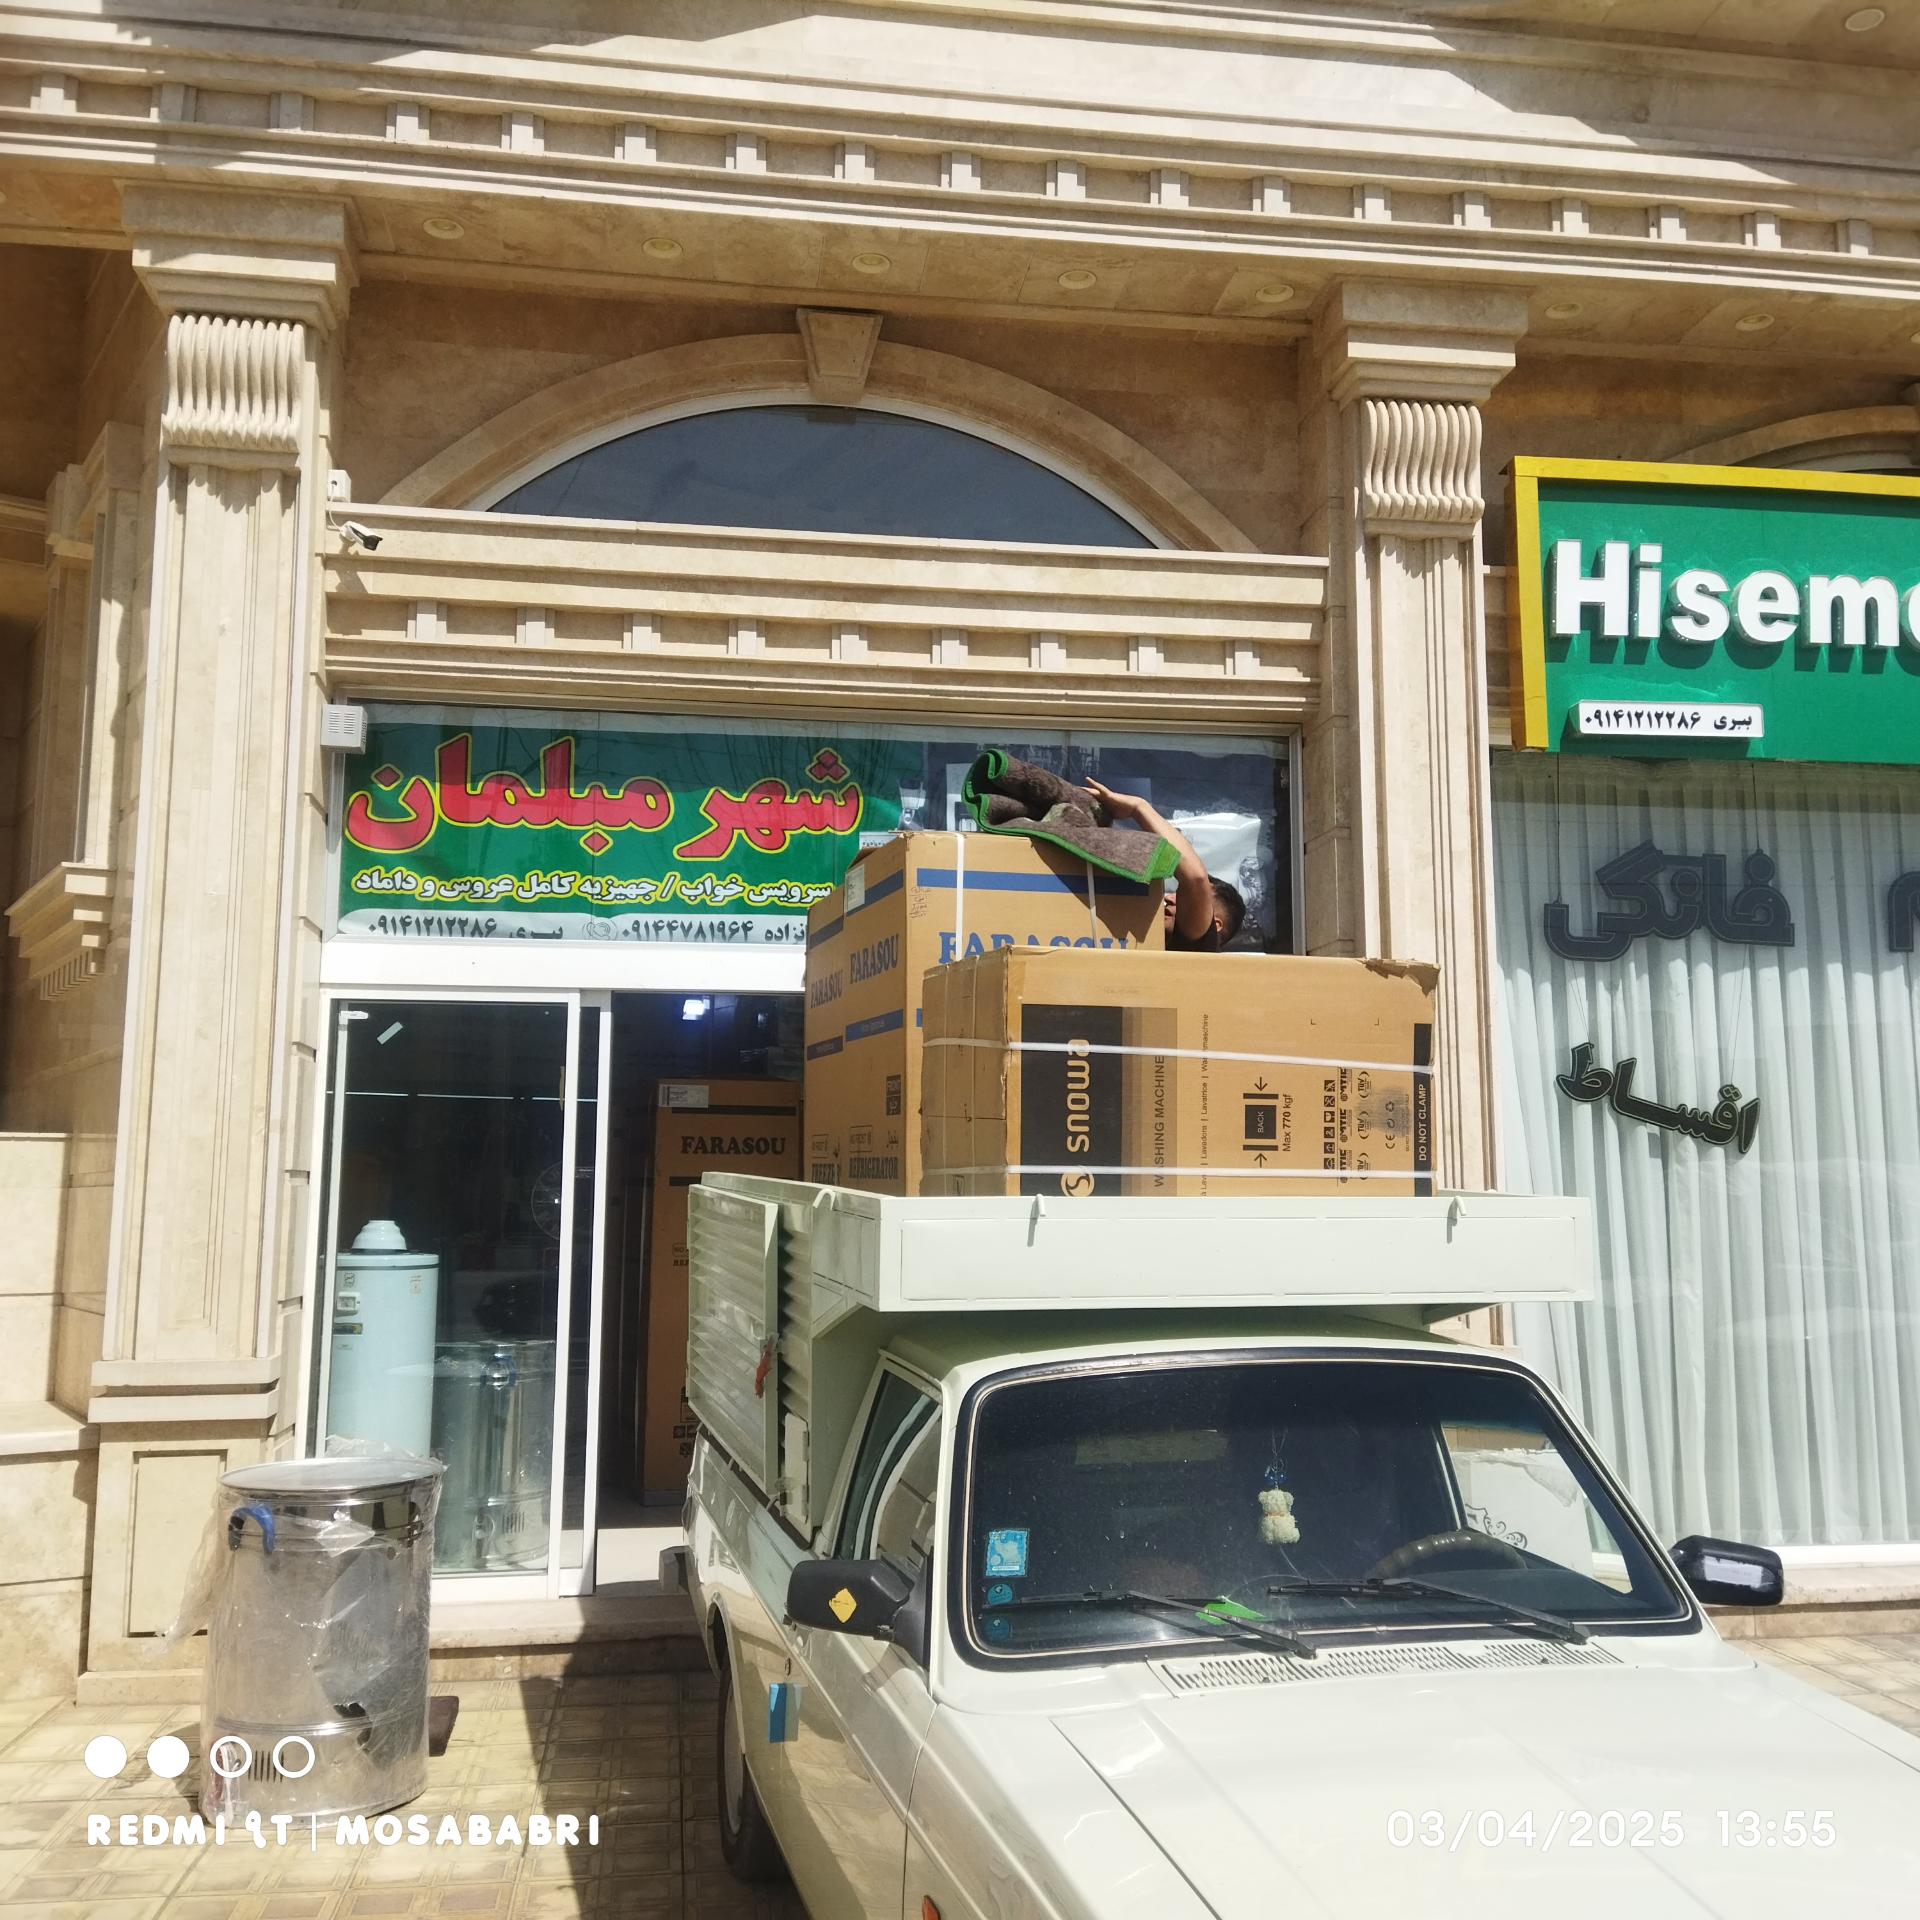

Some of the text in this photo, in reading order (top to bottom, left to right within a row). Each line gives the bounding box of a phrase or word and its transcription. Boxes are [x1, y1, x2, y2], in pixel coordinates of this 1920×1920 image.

[1552, 539, 1920, 648] Hisem
[1585, 709, 1701, 730] ۰۹۱۴۱۲۱۲۲۸۶
[346, 735, 861, 859] شهر مبلمان
[354, 869, 418, 891] داماد
[421, 879, 436, 898] و
[439, 878, 514, 899] عروس
[517, 873, 577, 899] کامل
[580, 877, 658, 901] جهیزیه
[681, 876, 745, 901] خواب
[748, 884, 832, 902] سرویس
[368, 915, 498, 937] ۰۹۱۴۱۲۱۲۲۸۶
[849, 933, 899, 985] FARASOU
[1066, 1039, 1091, 1153] snowa
[1556, 1042, 1761, 1155] اقساط
[1154, 1056, 1165, 1188] WSHING MACHINE
[1256, 1111, 1265, 1134] BACK
[1282, 1094, 1294, 1152] Max 770 kgf
[1418, 1084, 1428, 1161] DO NOT CLAMP
[680, 1135, 786, 1156] FARASOU
